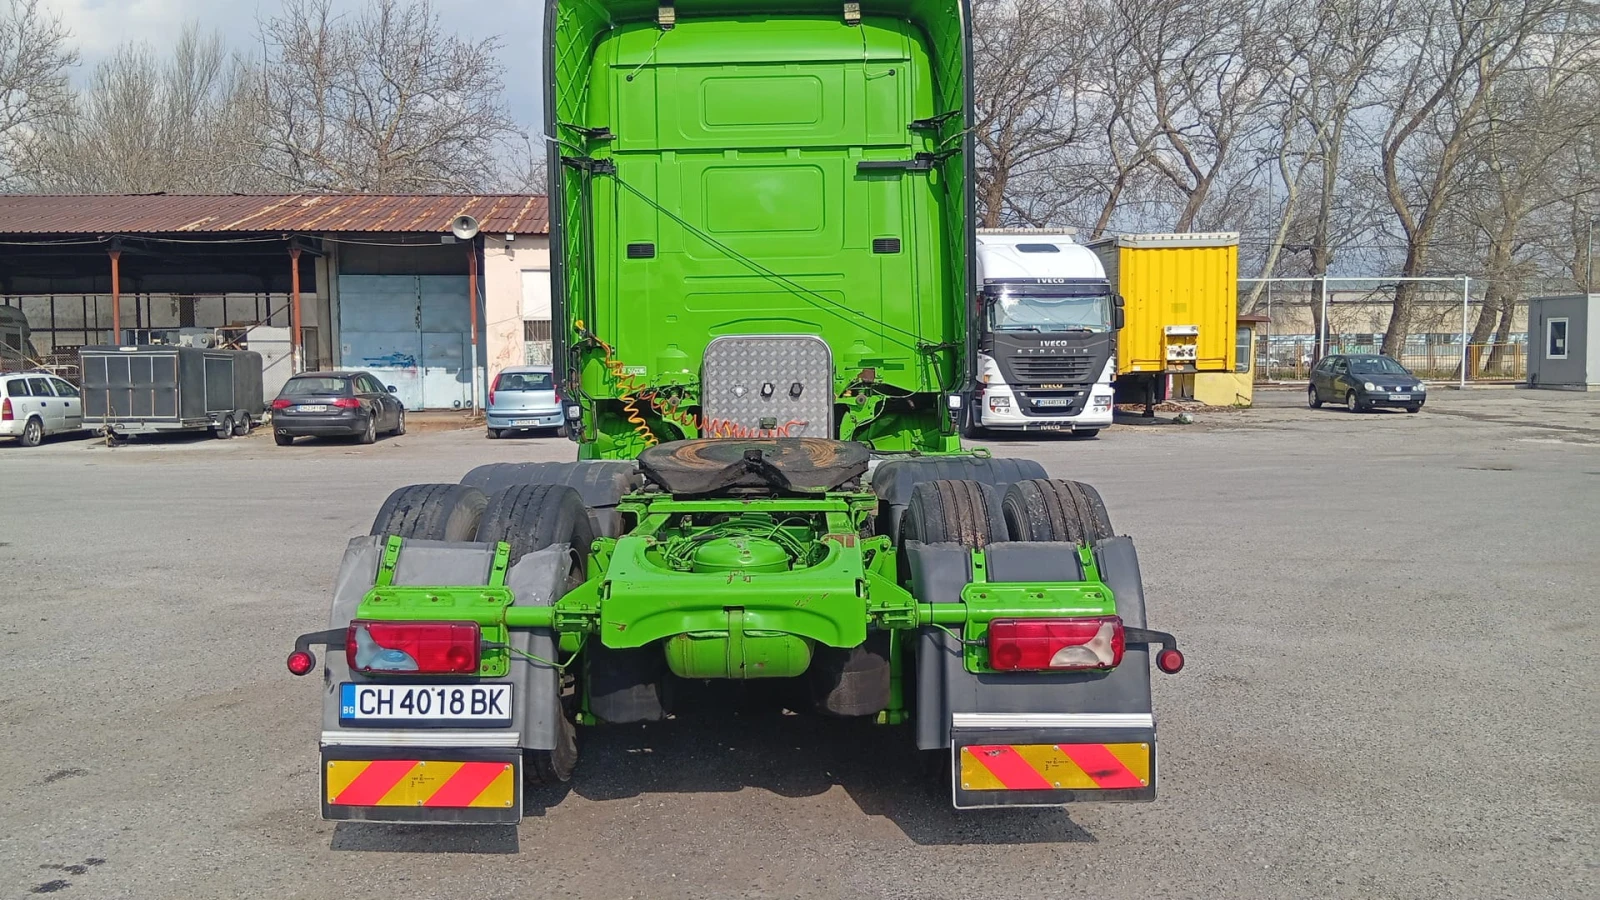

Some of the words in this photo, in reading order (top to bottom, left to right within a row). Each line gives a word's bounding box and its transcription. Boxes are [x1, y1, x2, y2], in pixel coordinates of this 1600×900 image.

[343, 706, 354, 714] BG
[359, 689, 394, 715] CH
[399, 689, 465, 715] 4018
[470, 689, 505, 715] BK
